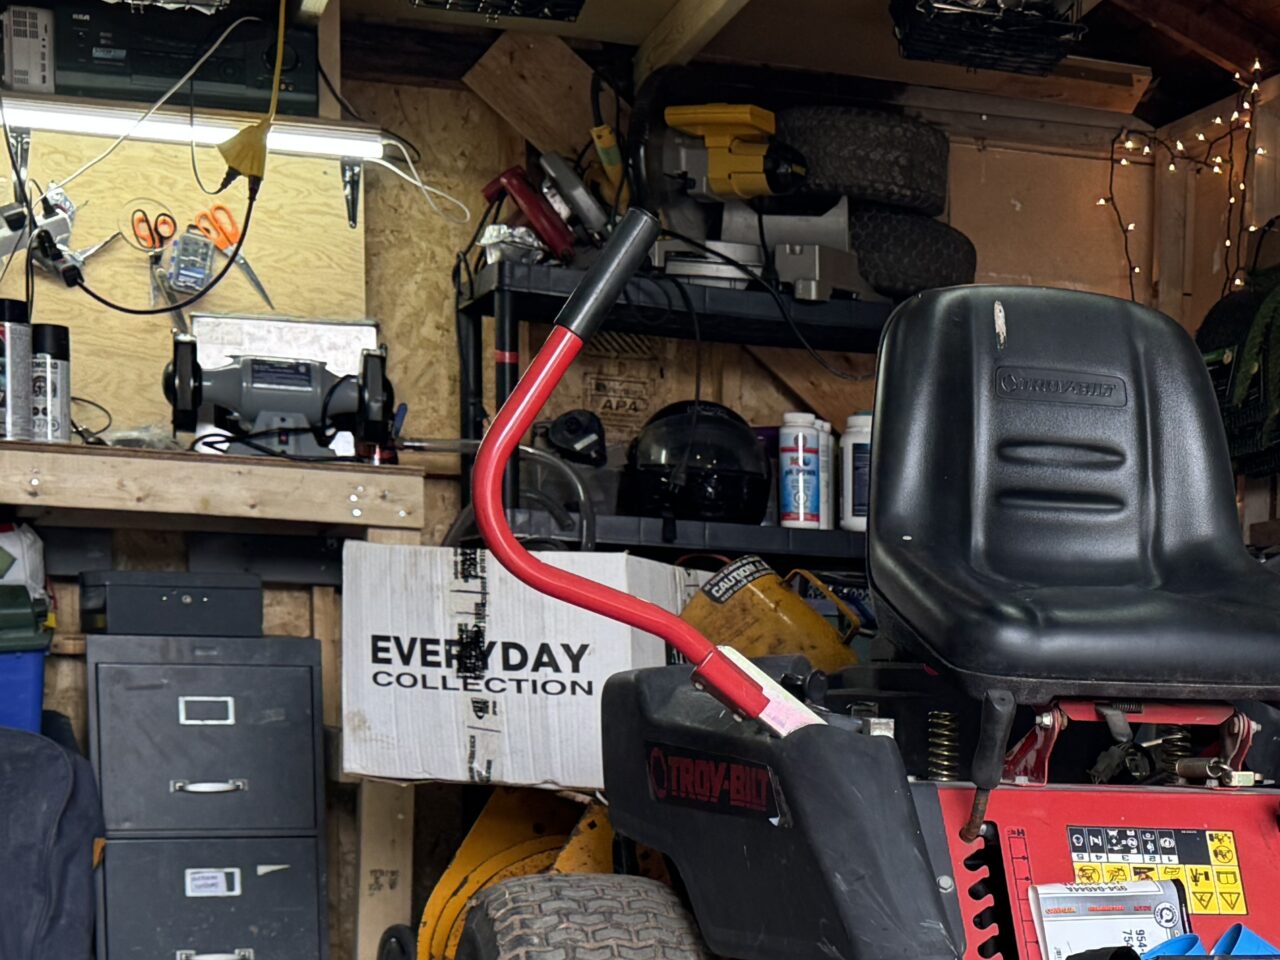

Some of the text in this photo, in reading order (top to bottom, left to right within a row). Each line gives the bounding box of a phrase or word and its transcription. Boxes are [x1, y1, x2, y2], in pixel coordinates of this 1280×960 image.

[601, 399, 639, 413] APA
[711, 562, 758, 598] CAUTION
[370, 634, 590, 674] EVERYDAY
[372, 670, 594, 696] COLLECTION
[667, 755, 769, 812] TROY-BILT
